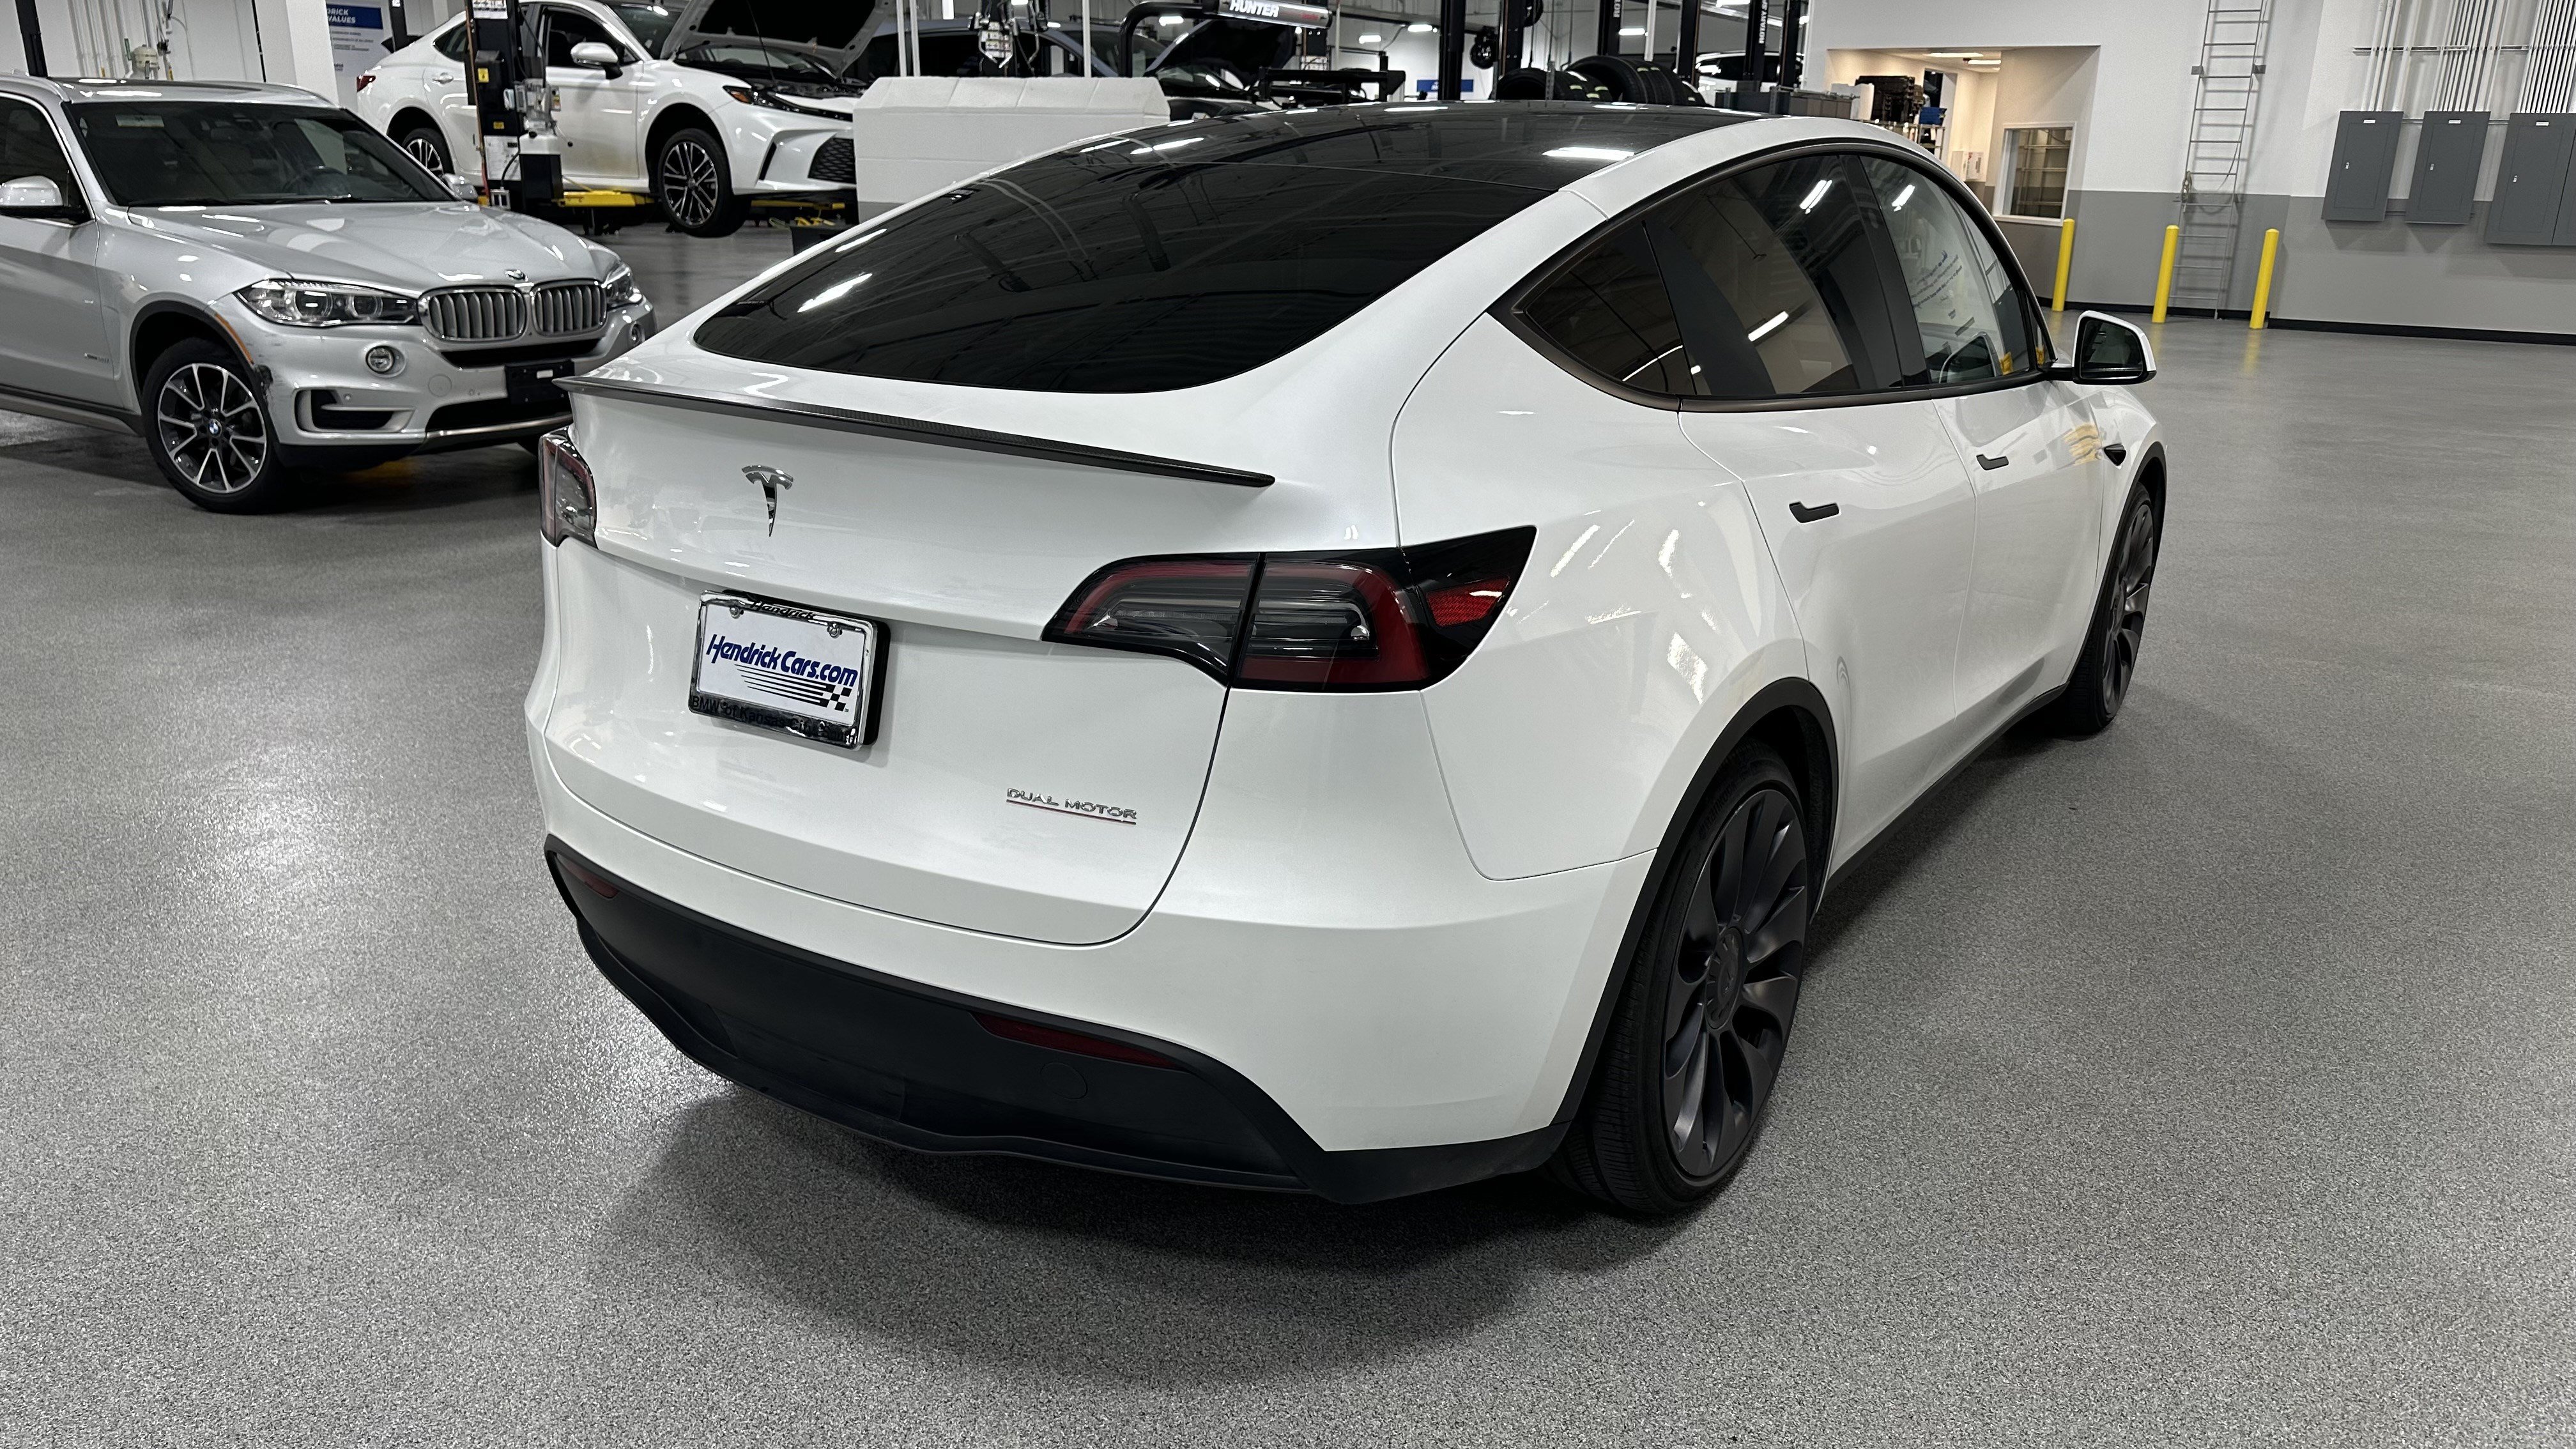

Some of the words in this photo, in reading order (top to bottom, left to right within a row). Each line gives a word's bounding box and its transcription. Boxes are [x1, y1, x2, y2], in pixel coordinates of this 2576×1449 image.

[327, 8, 349, 16] DRICK
[1229, 0, 1280, 17] HUNTER
[750, 600, 815, 619] Hendrick
[692, 696, 720, 714] BMW
[1008, 788, 1059, 806] DUAL
[1065, 799, 1137, 819] MOTOR
